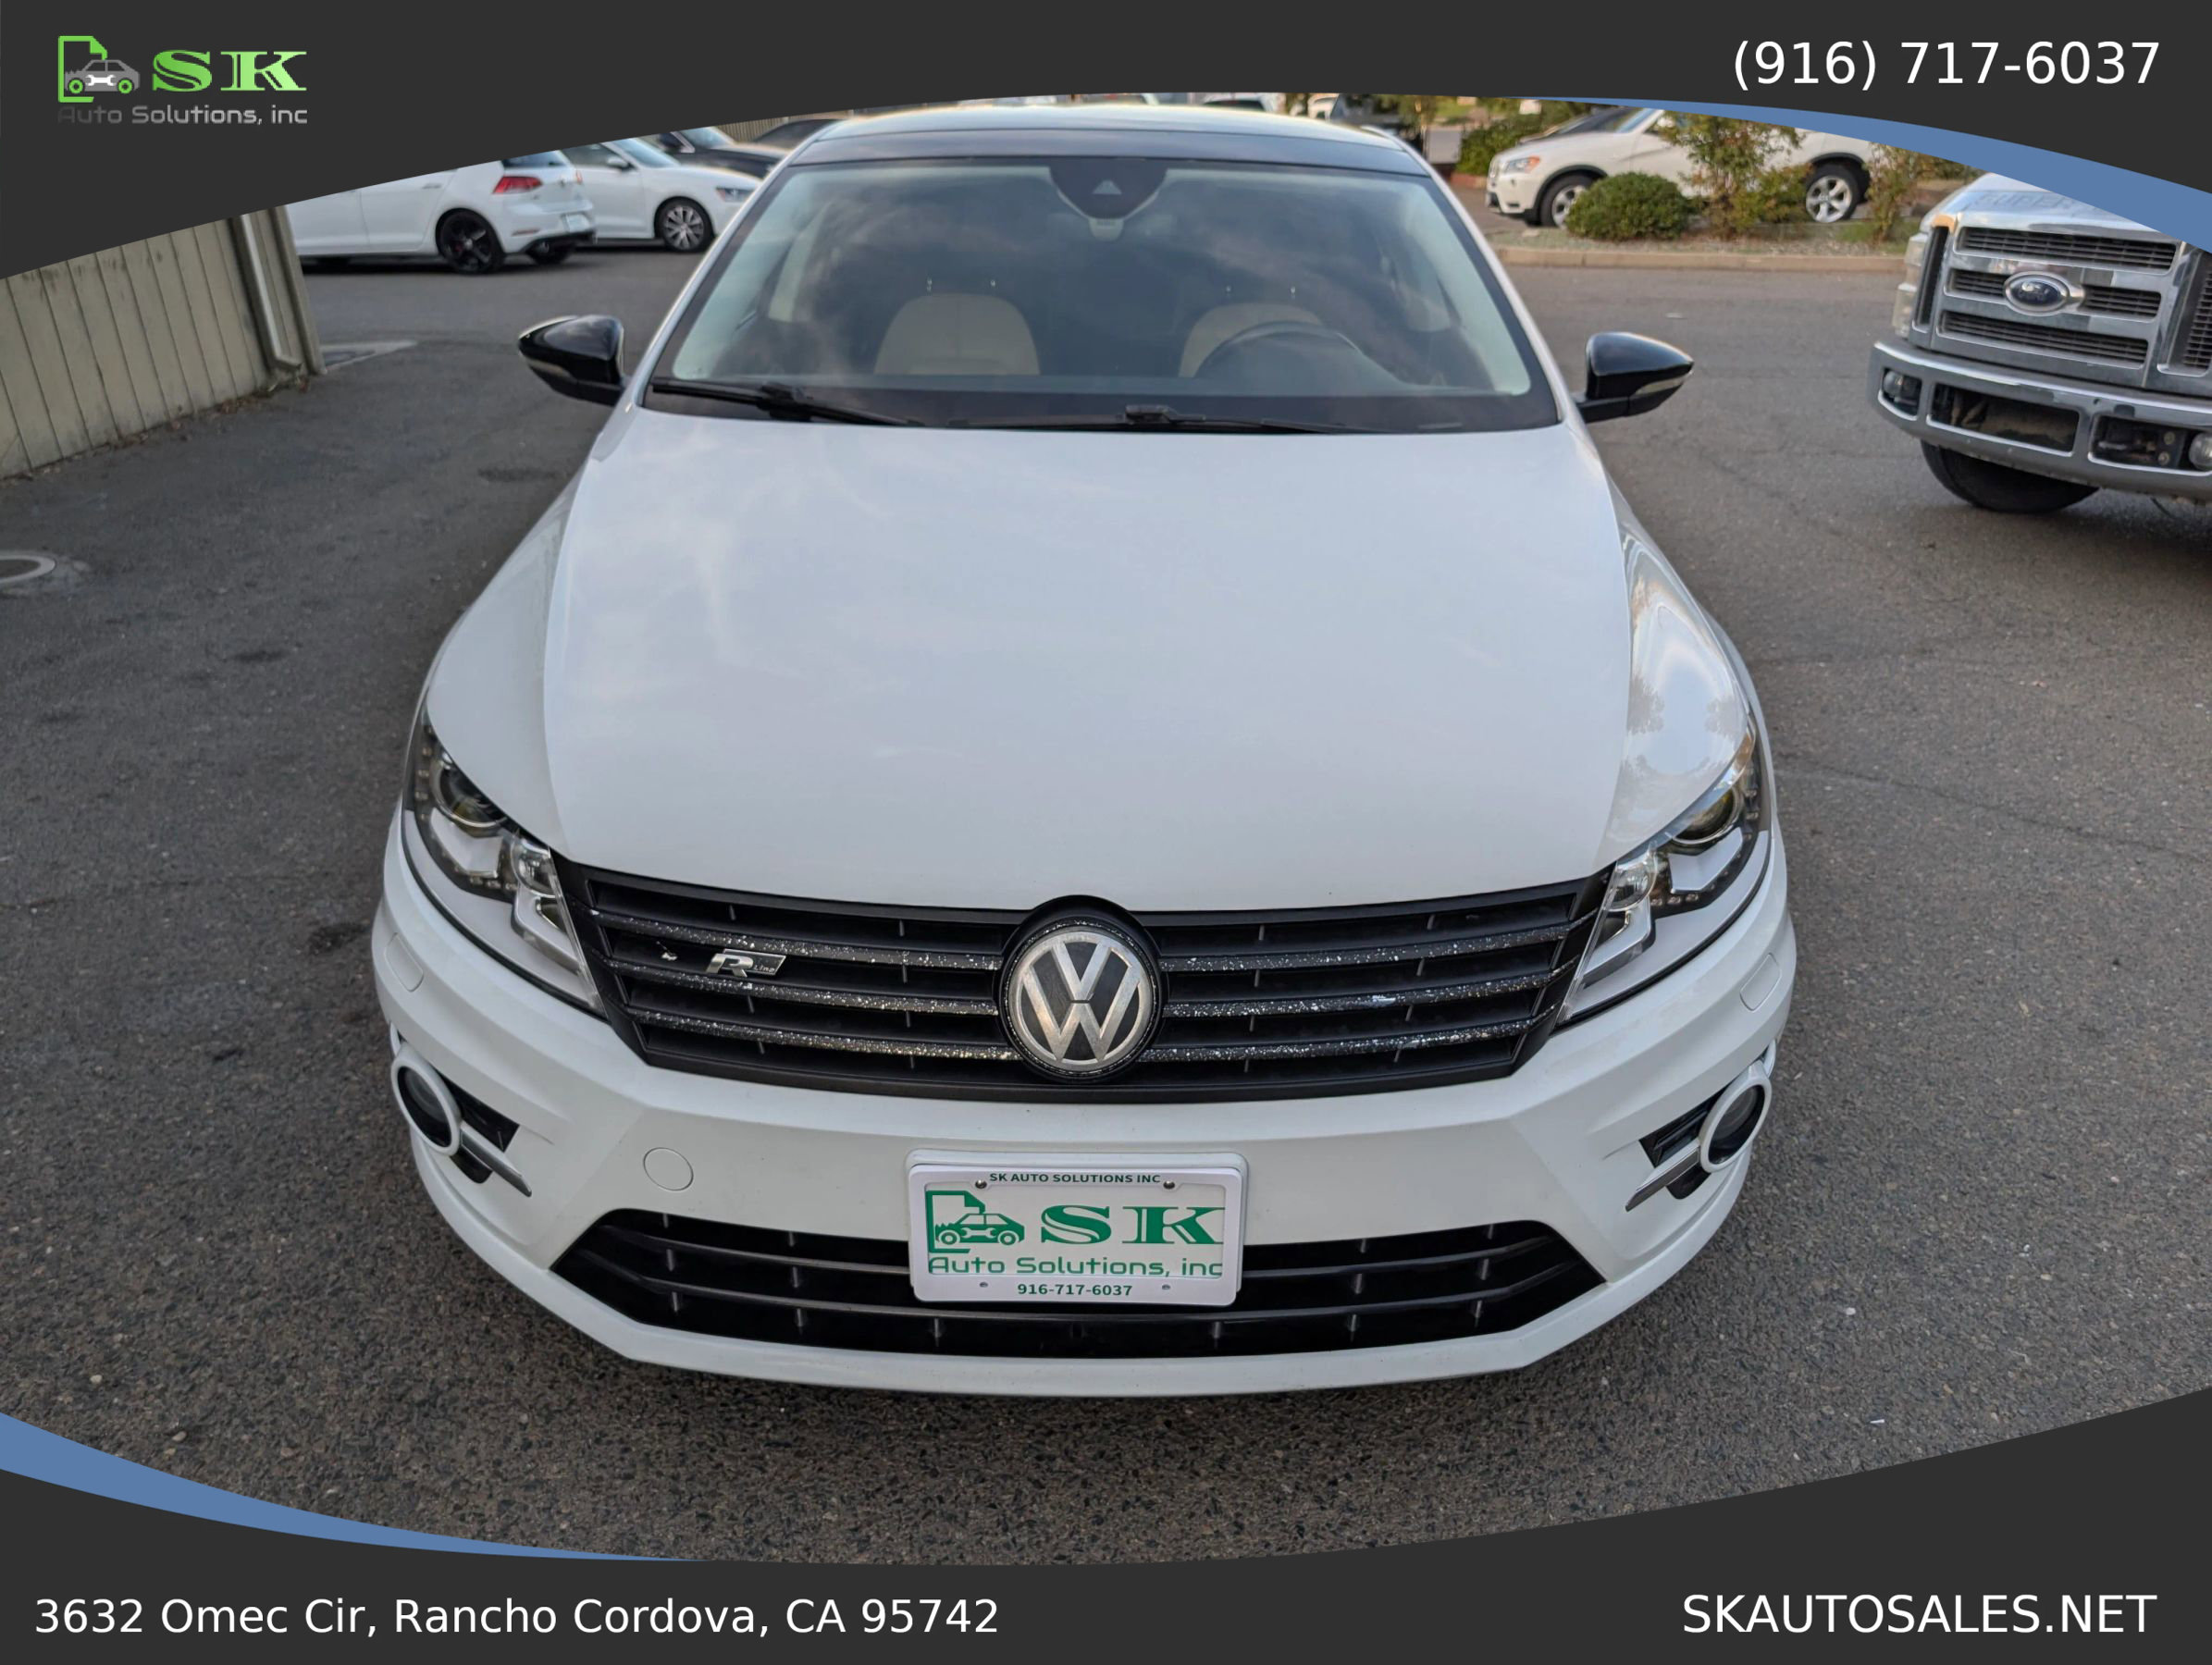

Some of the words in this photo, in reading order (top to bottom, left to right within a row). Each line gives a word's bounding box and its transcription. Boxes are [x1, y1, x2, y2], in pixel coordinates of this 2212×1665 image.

[989, 1172, 1007, 1182] SK
[1010, 1173, 1049, 1183] AUTO
[1053, 1174, 1132, 1184] SOLUTIONS
[1136, 1175, 1161, 1184] INC
[1040, 1204, 1225, 1245] SK
[928, 1256, 1006, 1275] Auto
[1017, 1256, 1170, 1277] Solutions,
[1182, 1257, 1223, 1276] inc
[1017, 1283, 1133, 1296] 916-717-6037
